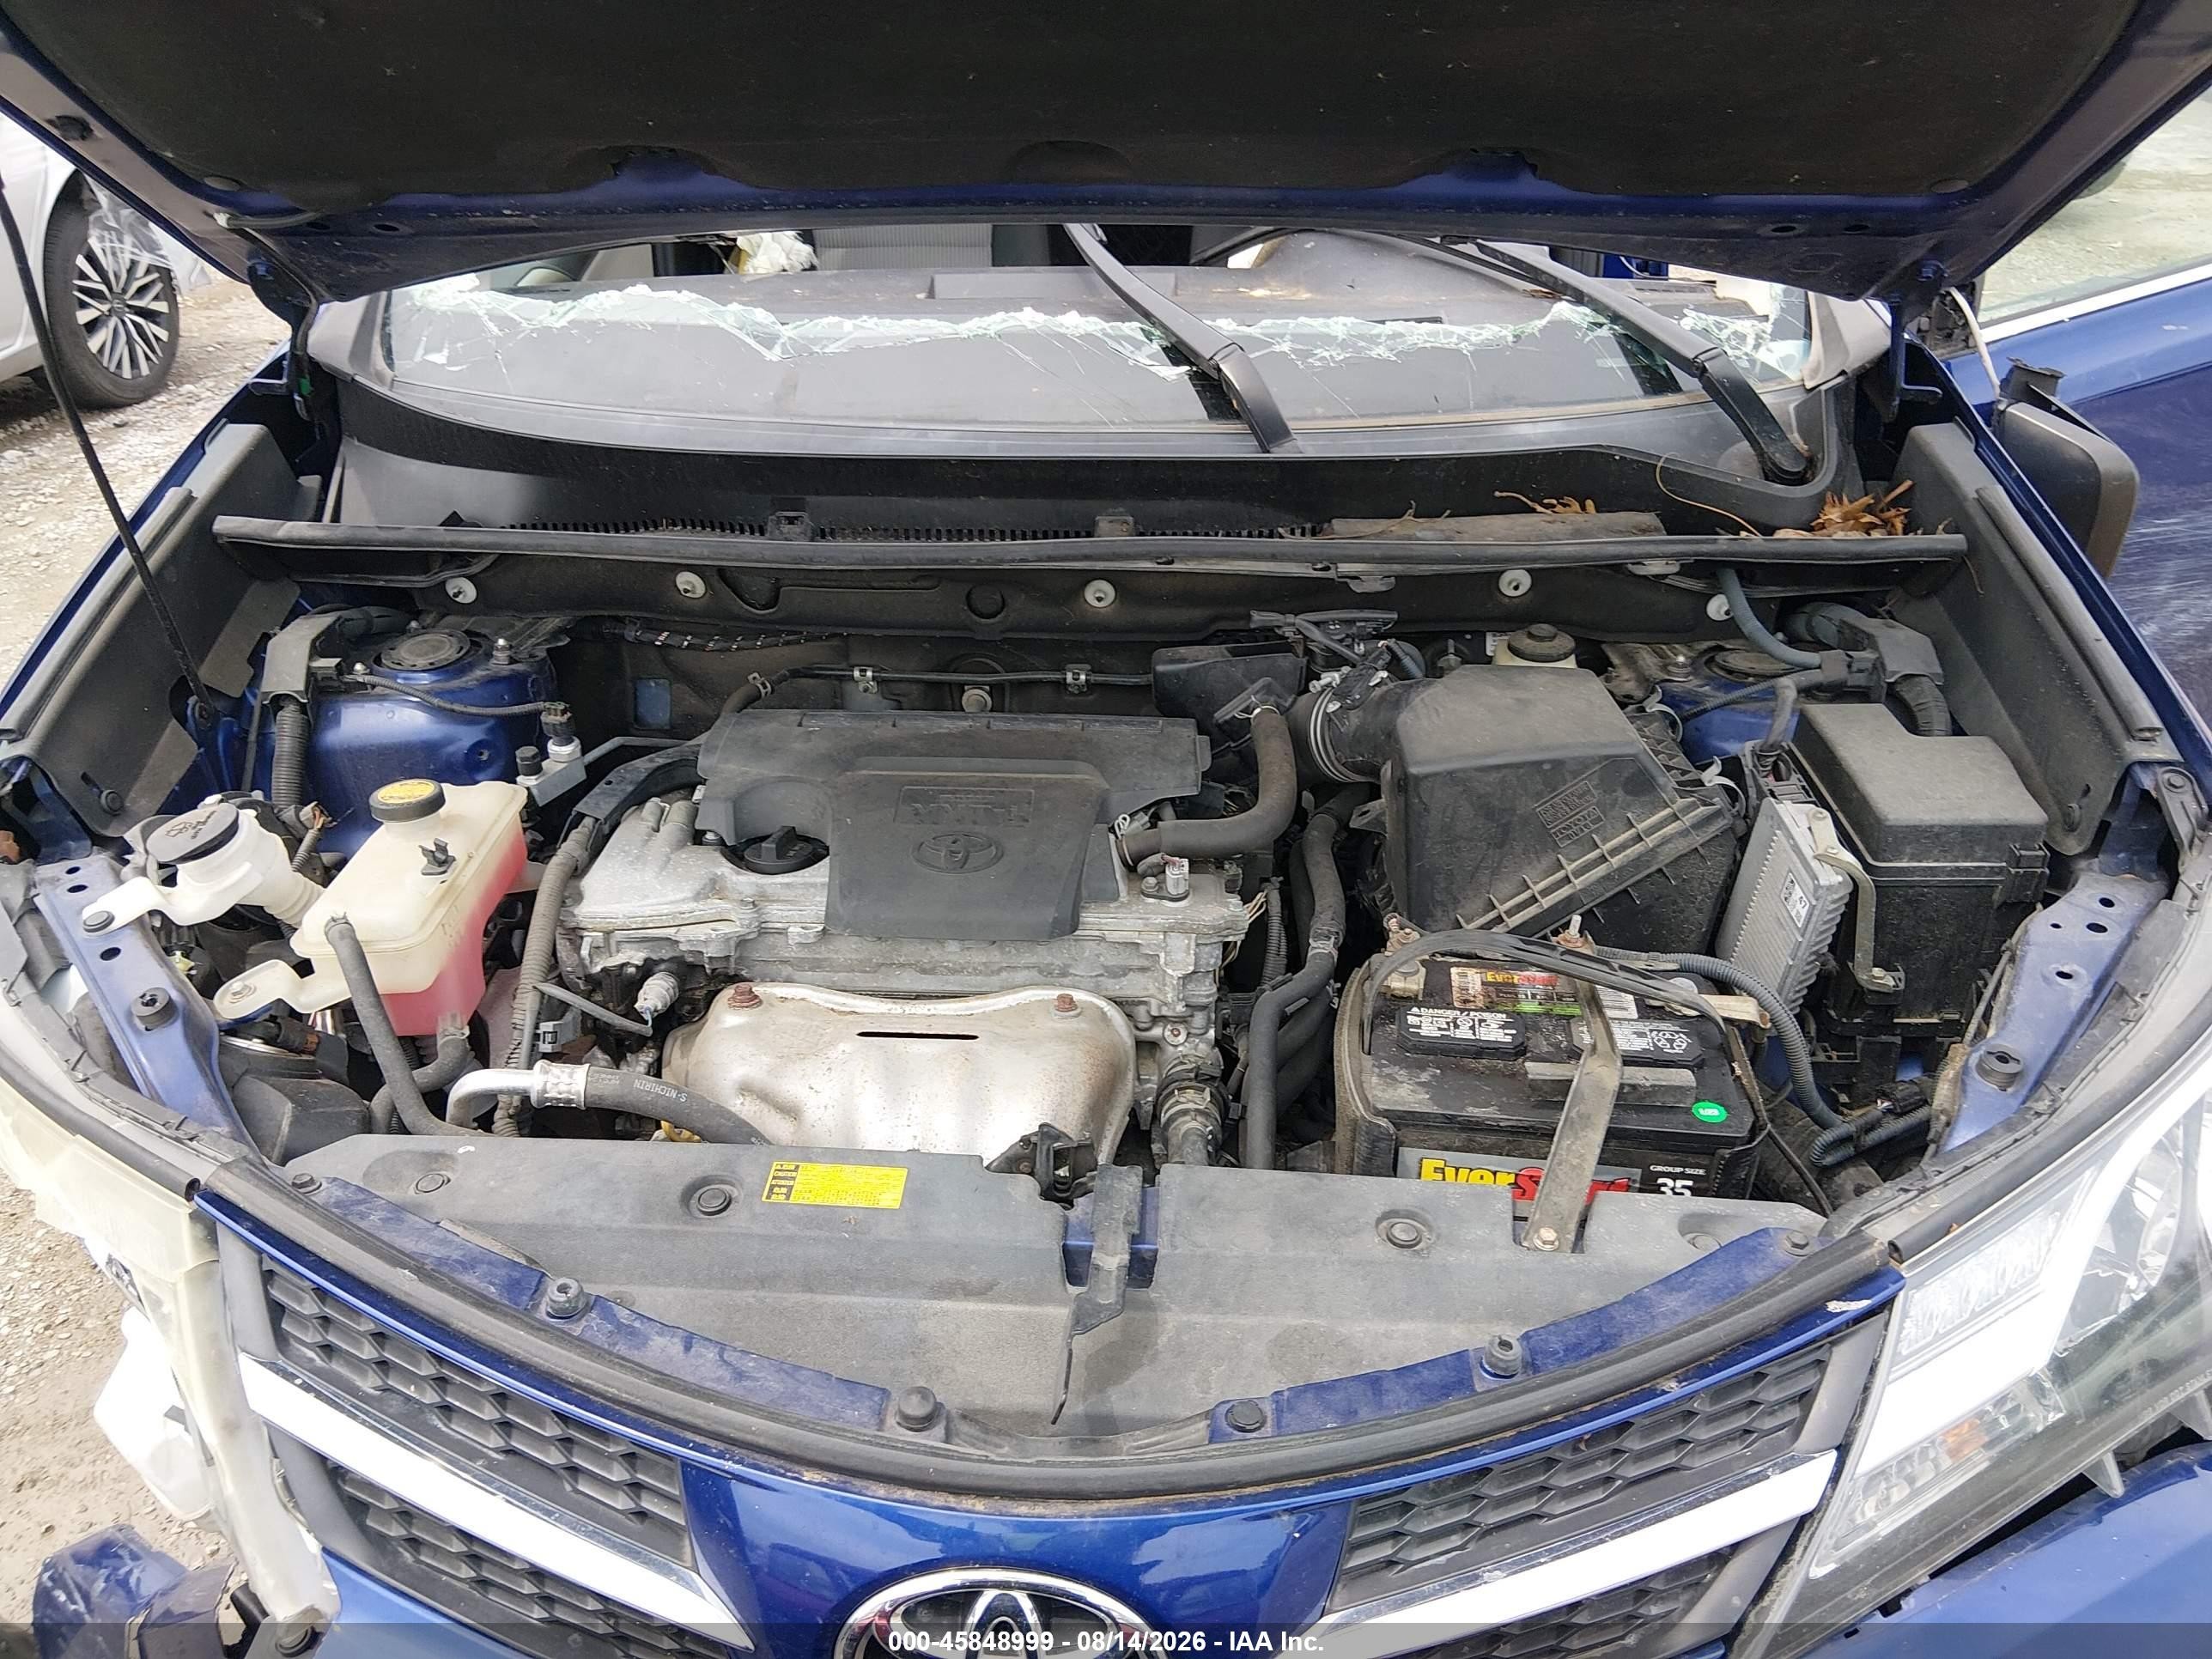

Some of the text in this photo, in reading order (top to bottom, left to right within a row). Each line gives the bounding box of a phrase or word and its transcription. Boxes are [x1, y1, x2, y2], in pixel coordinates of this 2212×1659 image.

[1420, 1007, 1460, 1018] DANGER
[1470, 1012, 1507, 1020] POISON
[634, 1078, 688, 1103] S-NICHIRIN
[1650, 1164, 1706, 1176] GROUP SIZE
[1656, 1177, 1694, 1197] 35
